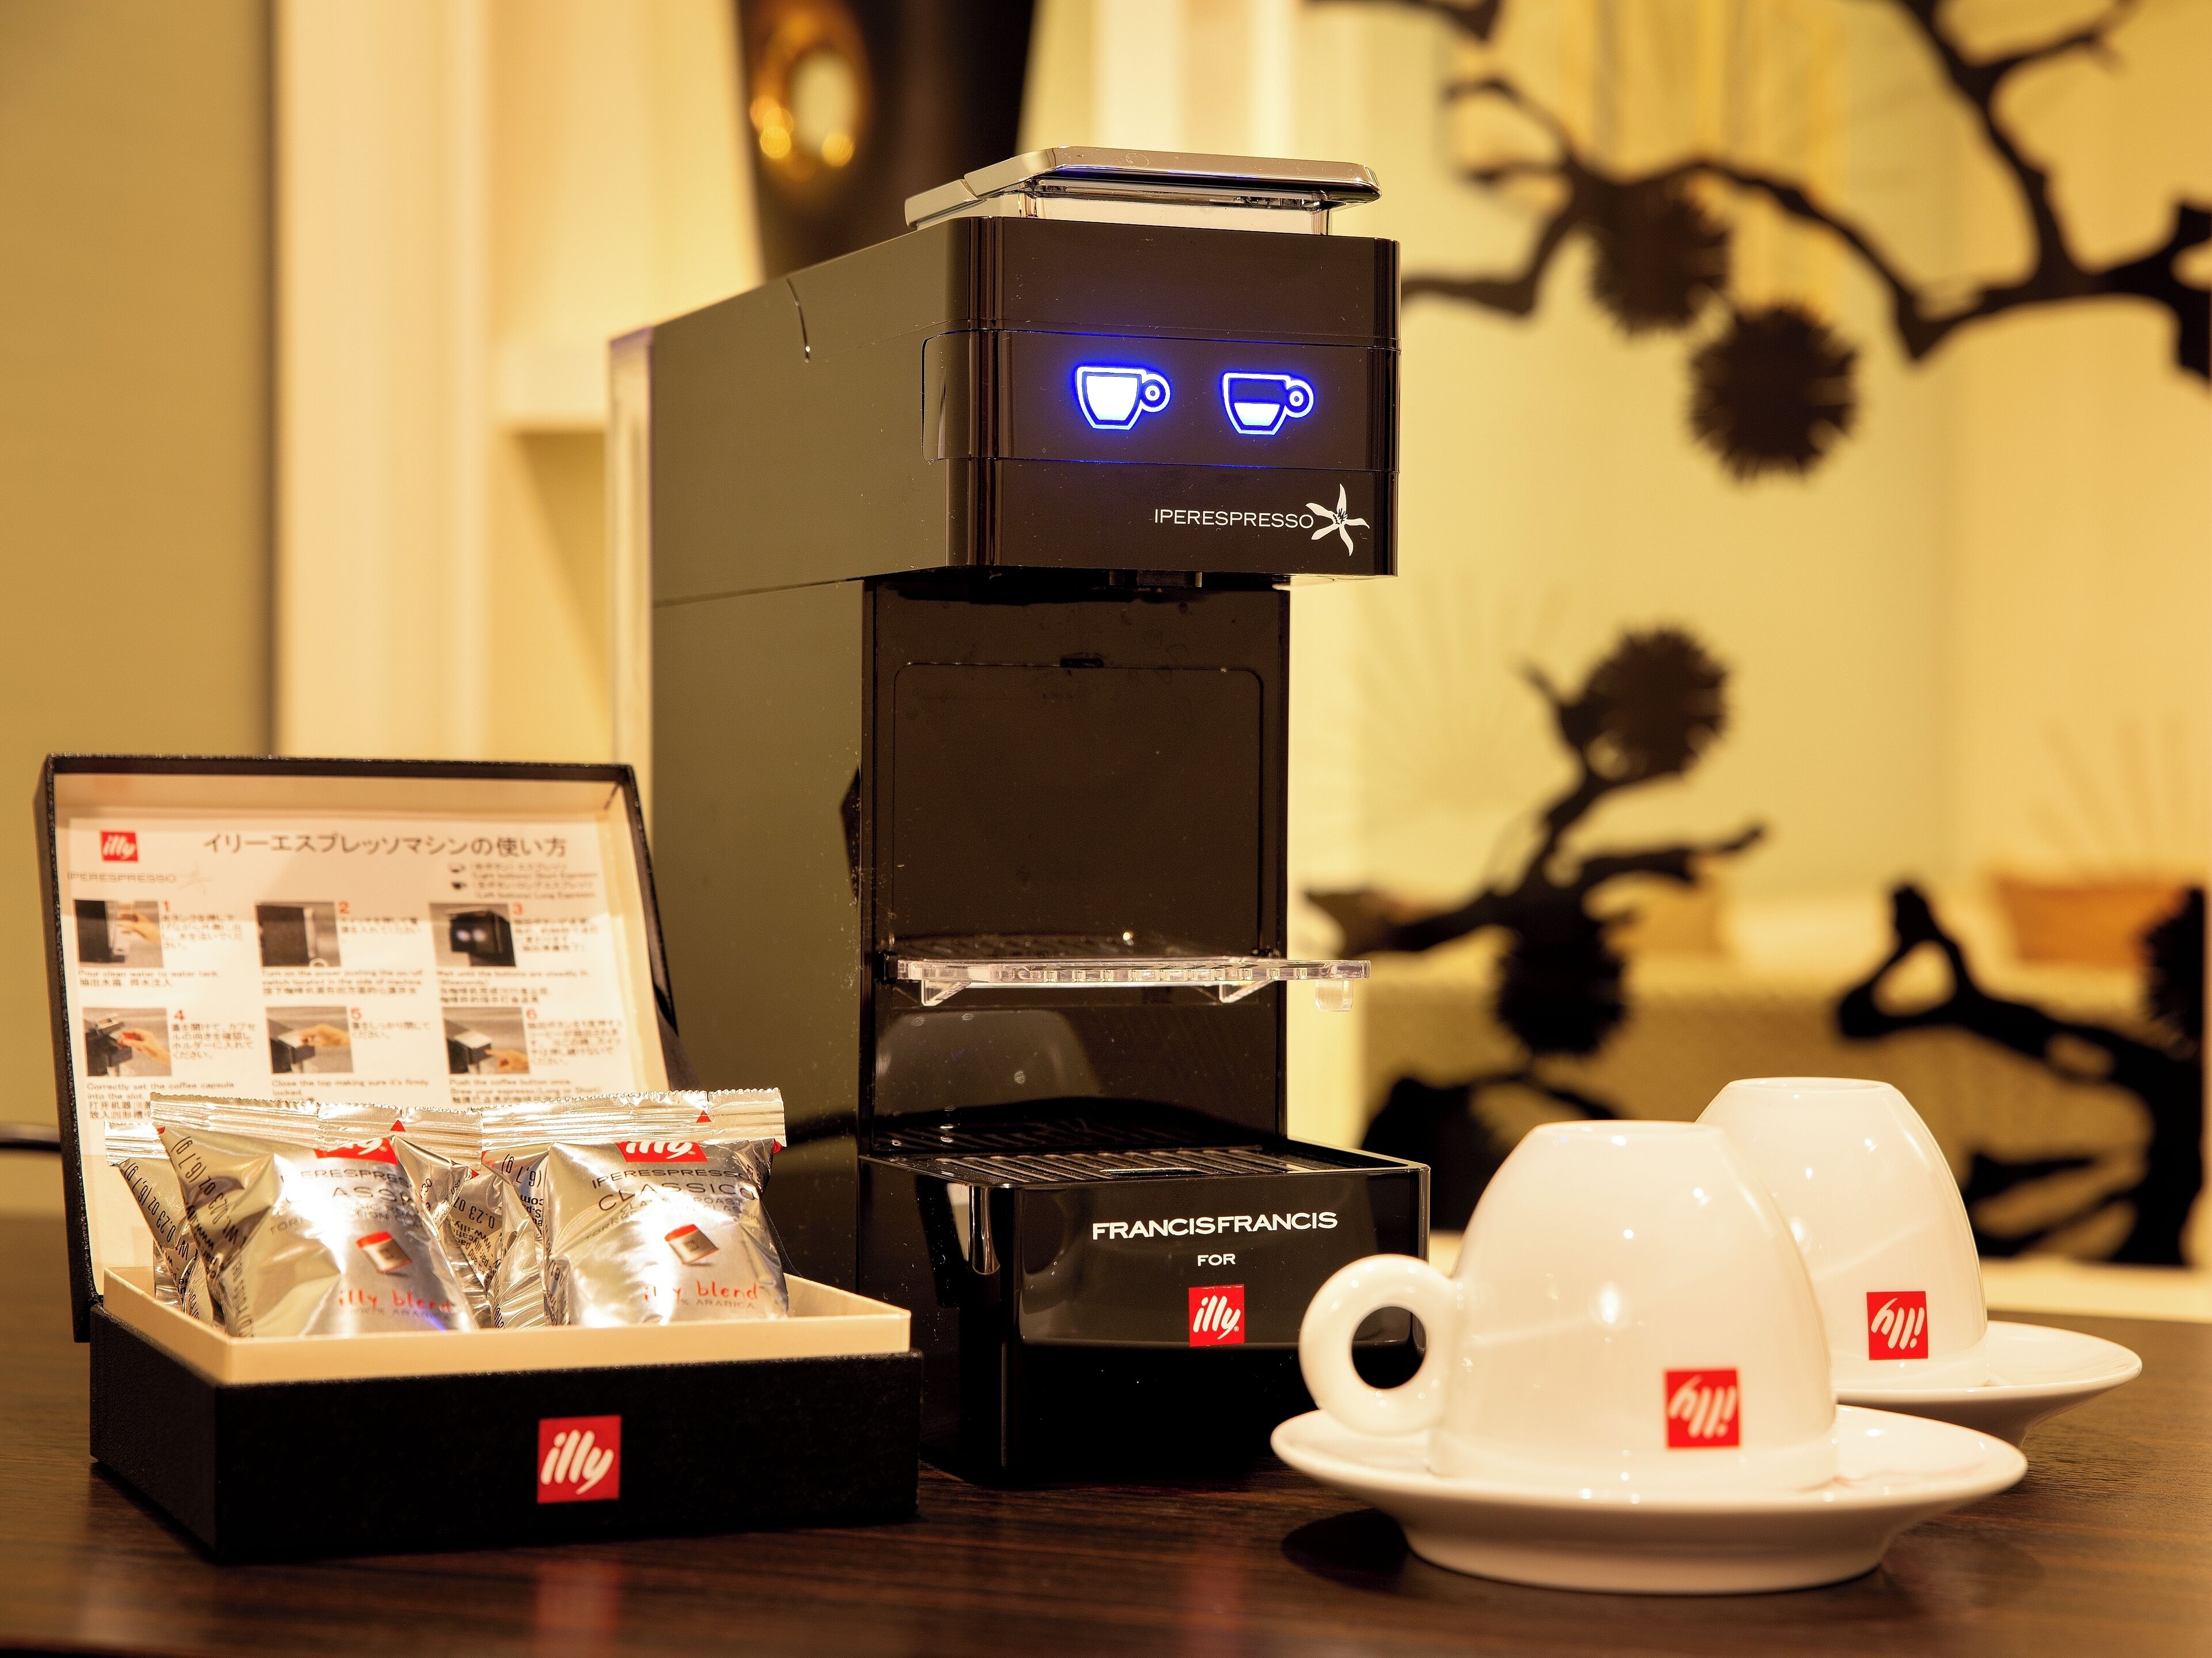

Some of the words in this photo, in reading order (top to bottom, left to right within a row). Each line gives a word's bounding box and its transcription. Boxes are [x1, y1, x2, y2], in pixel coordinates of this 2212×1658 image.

[1154, 508, 1314, 529] IPERESPRESSO
[103, 834, 137, 861] illy
[67, 870, 177, 884] IPERESPRESSO
[162, 899, 169, 912] 1
[338, 900, 350, 914] 2
[513, 902, 524, 915] 3
[173, 1009, 185, 1021] 4
[350, 1007, 362, 1020] 5
[526, 1008, 537, 1020] 6
[171, 1135, 193, 1155] g)
[501, 1153, 514, 1175] g)
[591, 1169, 752, 1190] IPERESPRESSO
[599, 1182, 756, 1212] CLASSICO
[156, 1210, 176, 1243] 0.23
[468, 1206, 495, 1229] 0.23
[1092, 1211, 1338, 1240] FRANCISFRANCIS
[1197, 1252, 1236, 1267] FOR
[339, 1289, 378, 1309] illy
[696, 1280, 759, 1300] blend
[1192, 1294, 1241, 1340] illy
[1870, 1297, 1926, 1350] illy
[1668, 1373, 1738, 1440] illy
[540, 1428, 615, 1496] illy
